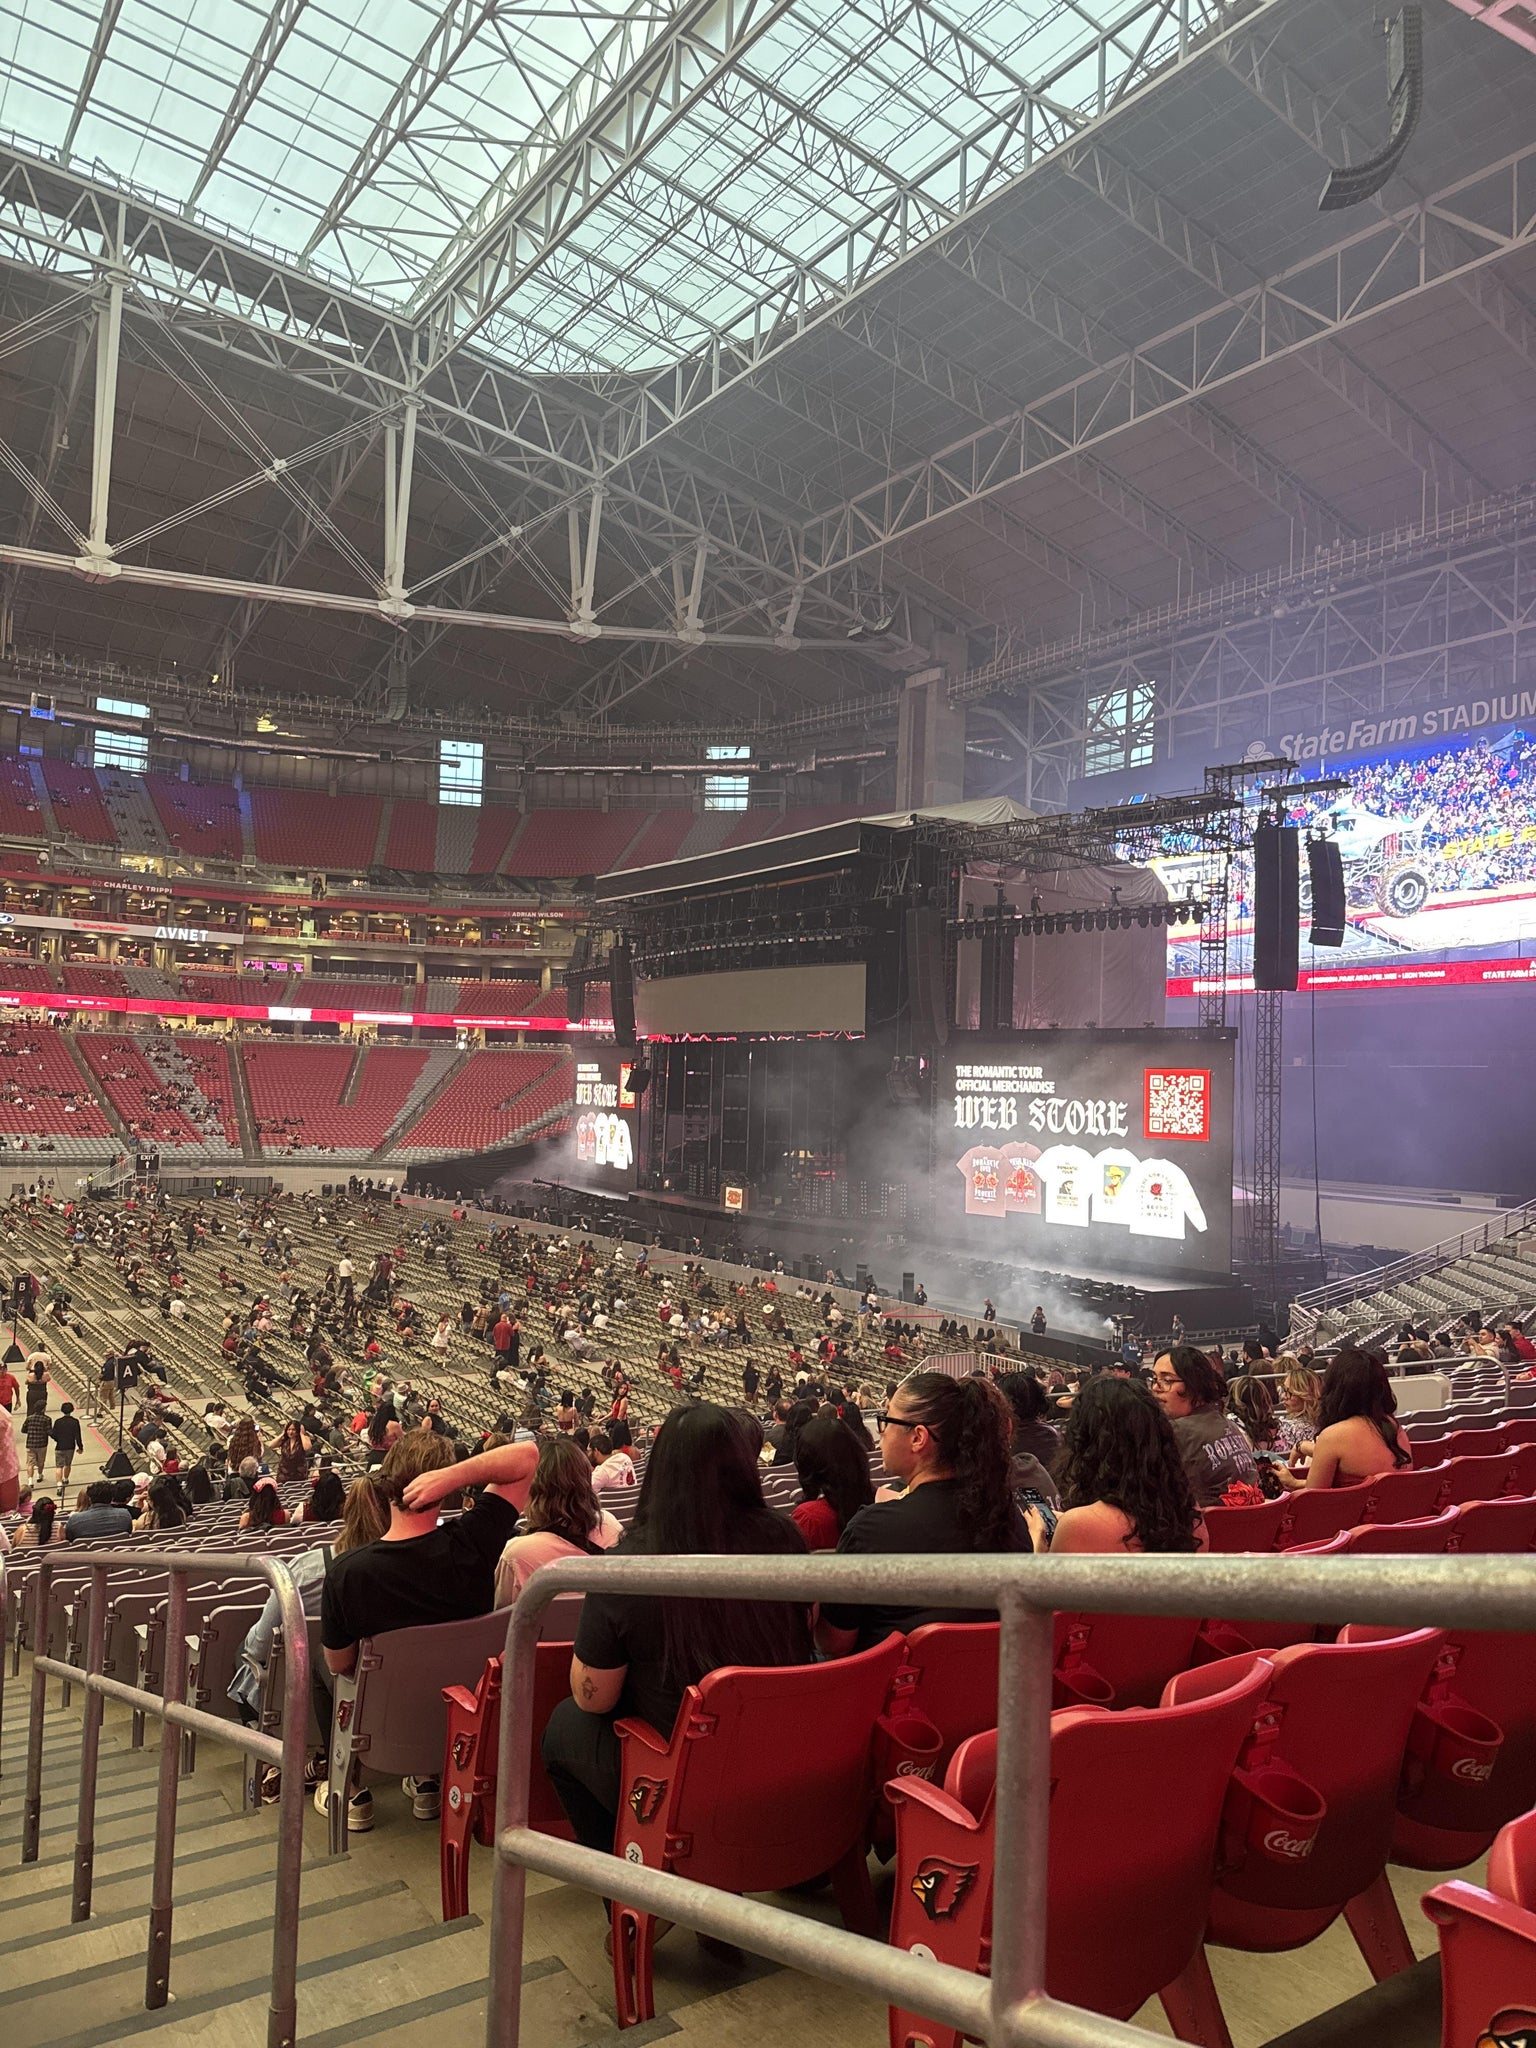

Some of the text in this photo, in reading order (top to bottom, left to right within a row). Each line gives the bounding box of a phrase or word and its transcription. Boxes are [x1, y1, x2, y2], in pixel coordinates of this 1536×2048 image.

[1422, 691, 1536, 736] STADIUM
[1443, 831, 1514, 860] STATE
[103, 881, 144, 891] CHARLEY
[145, 885, 173, 894] TRIPPI
[1418, 970, 1445, 978] THOMAS
[1482, 970, 1506, 979] STATE
[1506, 970, 1528, 978] FARM
[955, 1065, 1043, 1079] THE ROMANTIC TOUR
[955, 1079, 1056, 1094] OFFICIAL MERCHANDISE
[954, 1095, 1129, 1138] WEB STORE
[18, 1282, 26, 1291] B
[123, 1365, 133, 1378] A
[629, 1849, 639, 1864] 23
